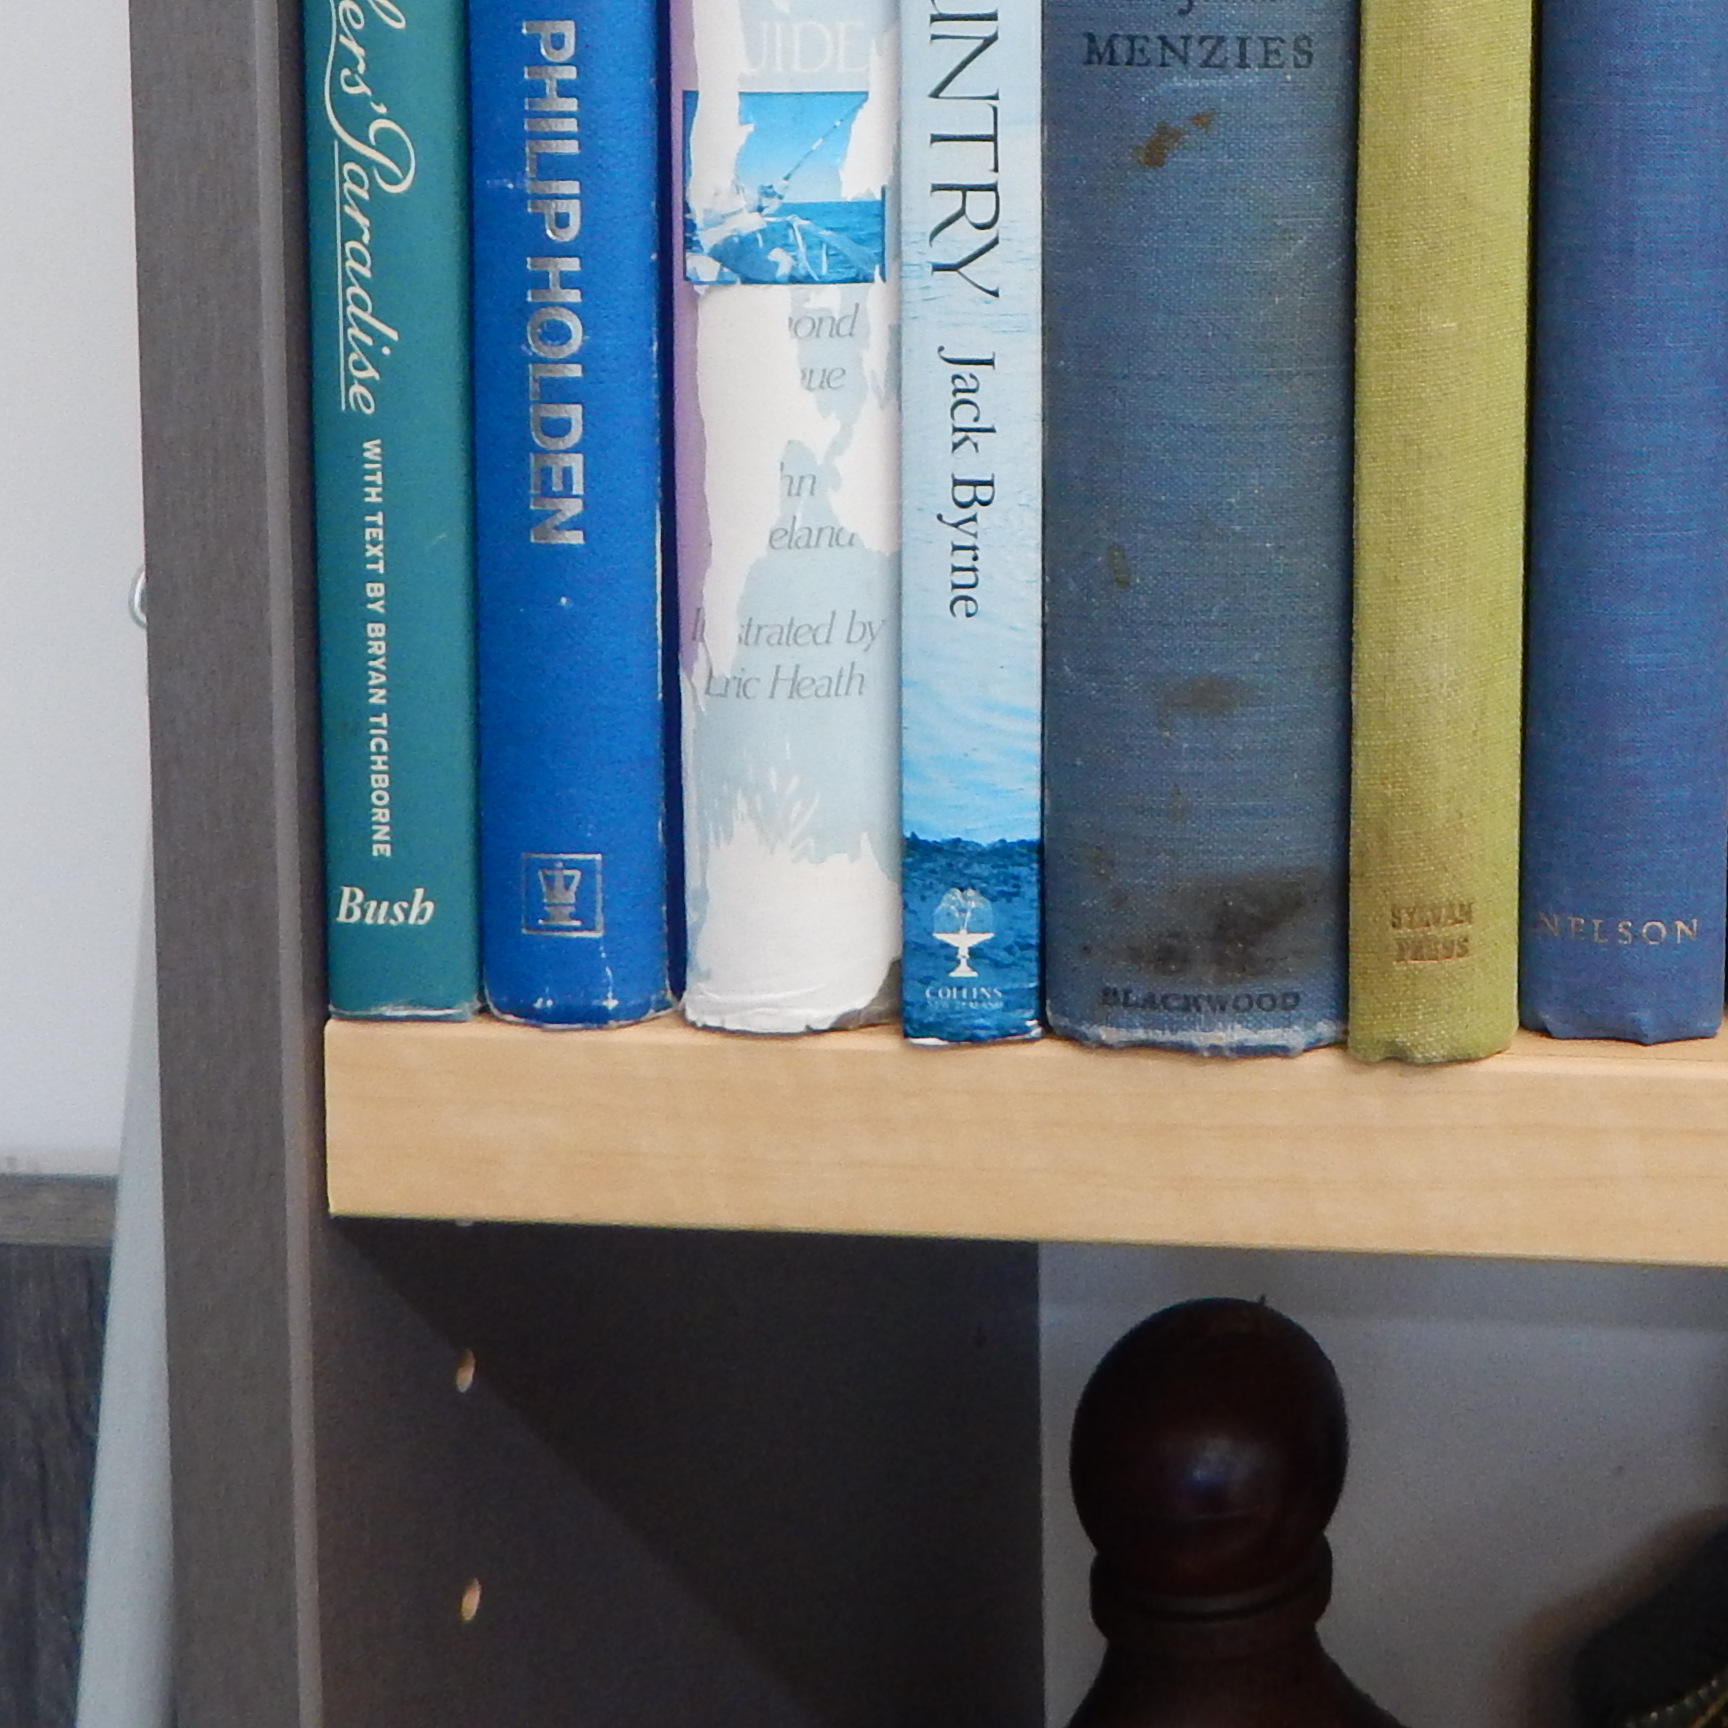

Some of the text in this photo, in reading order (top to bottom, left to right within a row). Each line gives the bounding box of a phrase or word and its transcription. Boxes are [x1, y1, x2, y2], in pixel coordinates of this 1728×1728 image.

[1083, 31, 1314, 69] MENZIES
[330, 100, 417, 415] Paradise
[521, 20, 585, 545] PHILIP HOLDEN
[937, 346, 997, 454] Jack
[937, 474, 996, 620] Byrne
[362, 437, 392, 858] WITH TEXT BY BRYAN TICHBORNE
[846, 608, 885, 653] by
[768, 660, 866, 700] Heath
[335, 884, 436, 926] Bush
[1536, 909, 1700, 945] NELSON
[1098, 986, 1300, 1013] BLACKWOOD
